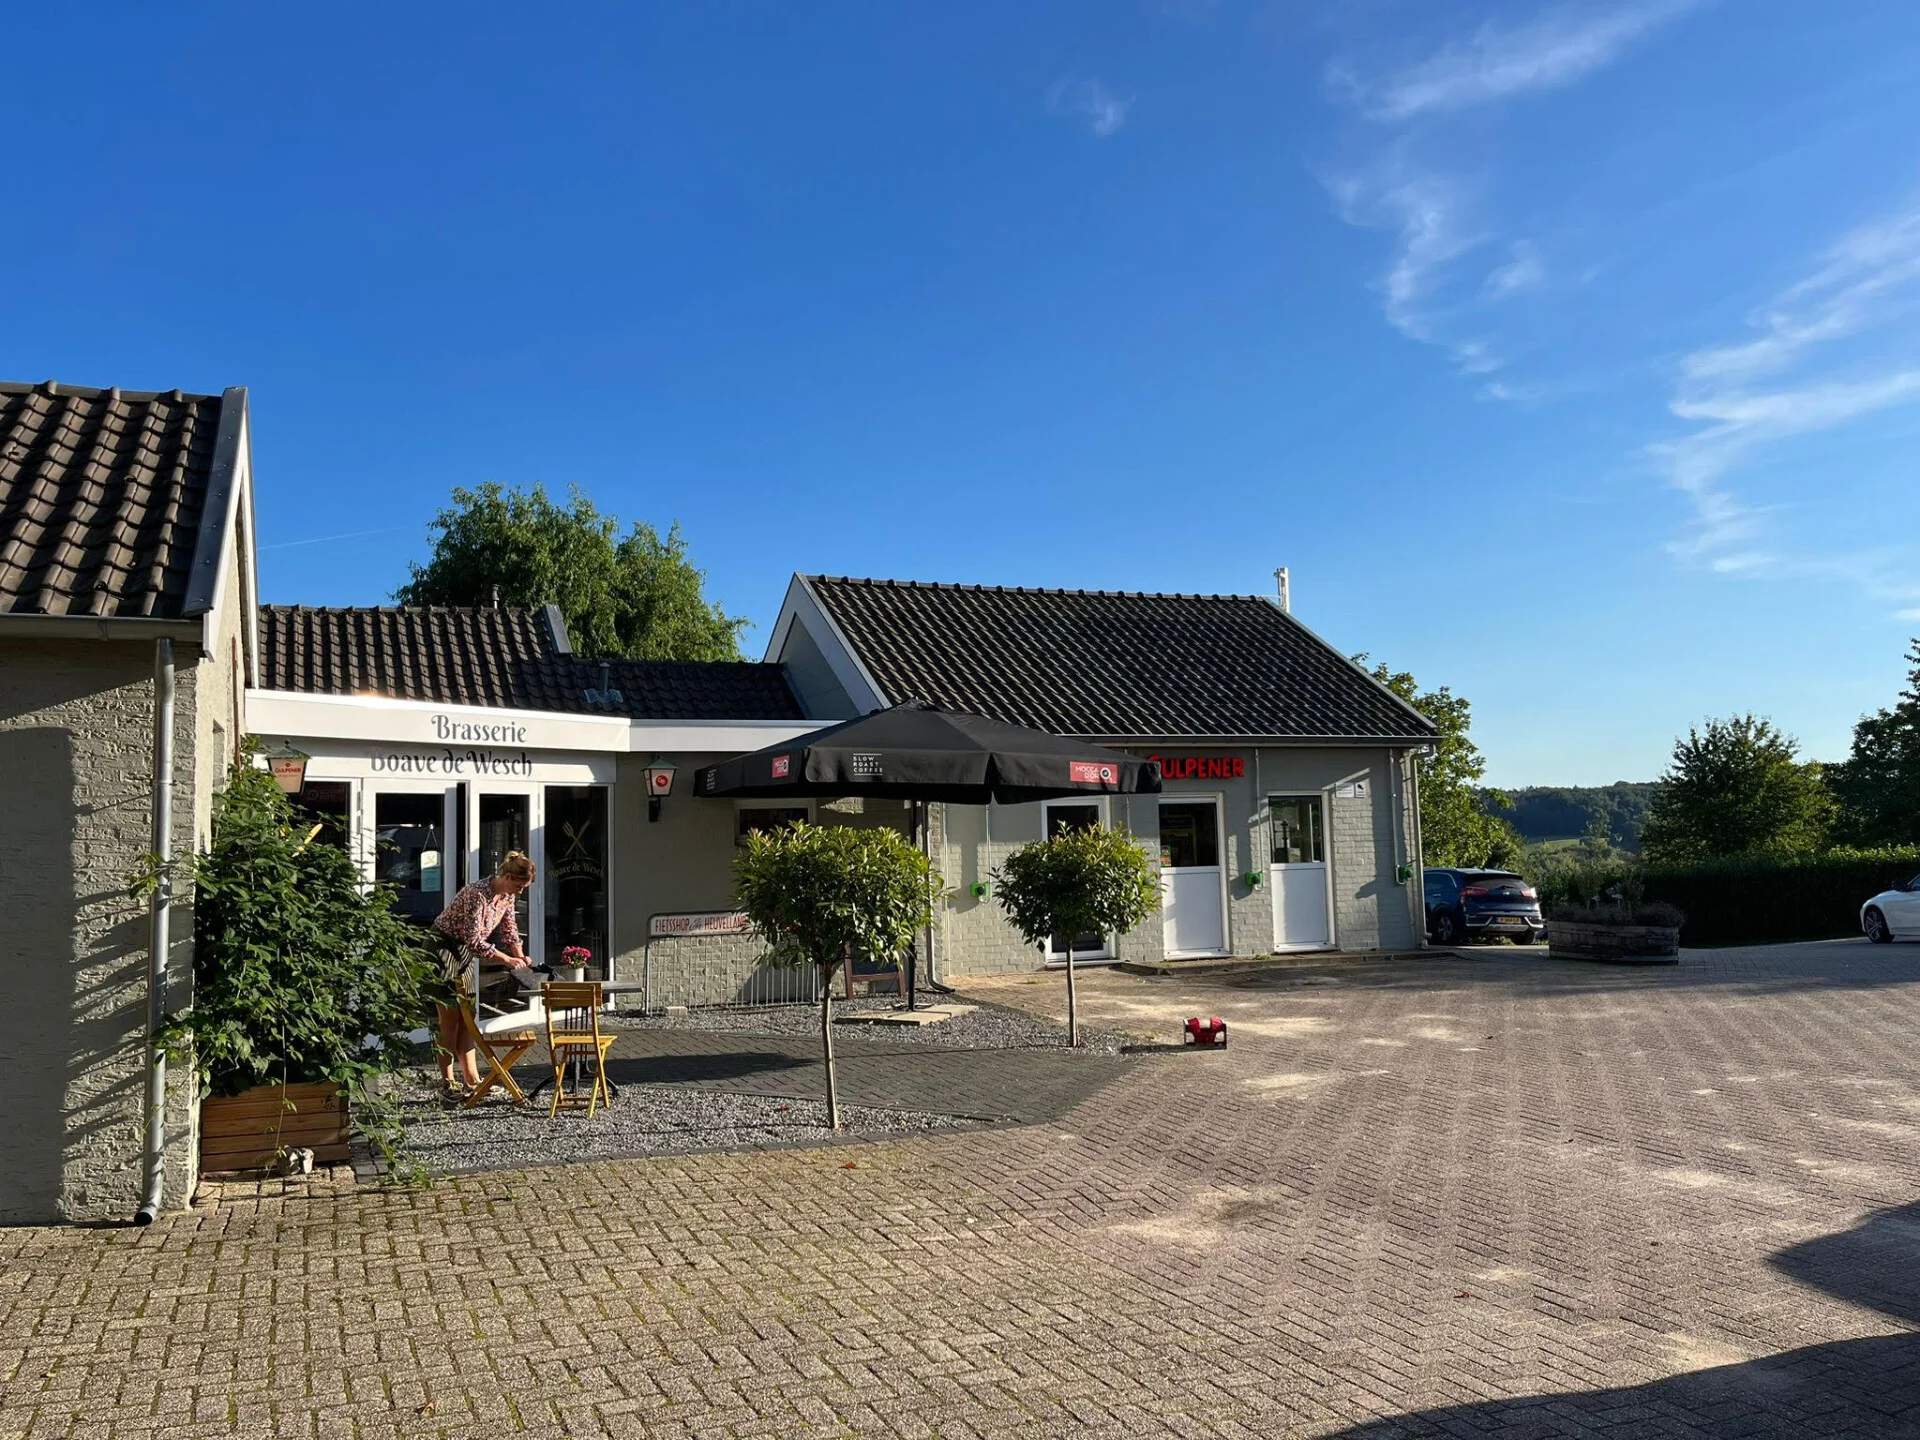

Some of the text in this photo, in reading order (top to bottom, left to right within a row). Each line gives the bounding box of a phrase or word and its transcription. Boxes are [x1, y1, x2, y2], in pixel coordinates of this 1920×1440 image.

[431, 714, 527, 743] Brasserie
[370, 748, 533, 777] Boave de Wesch
[655, 918, 689, 932] FIETSSHOP
